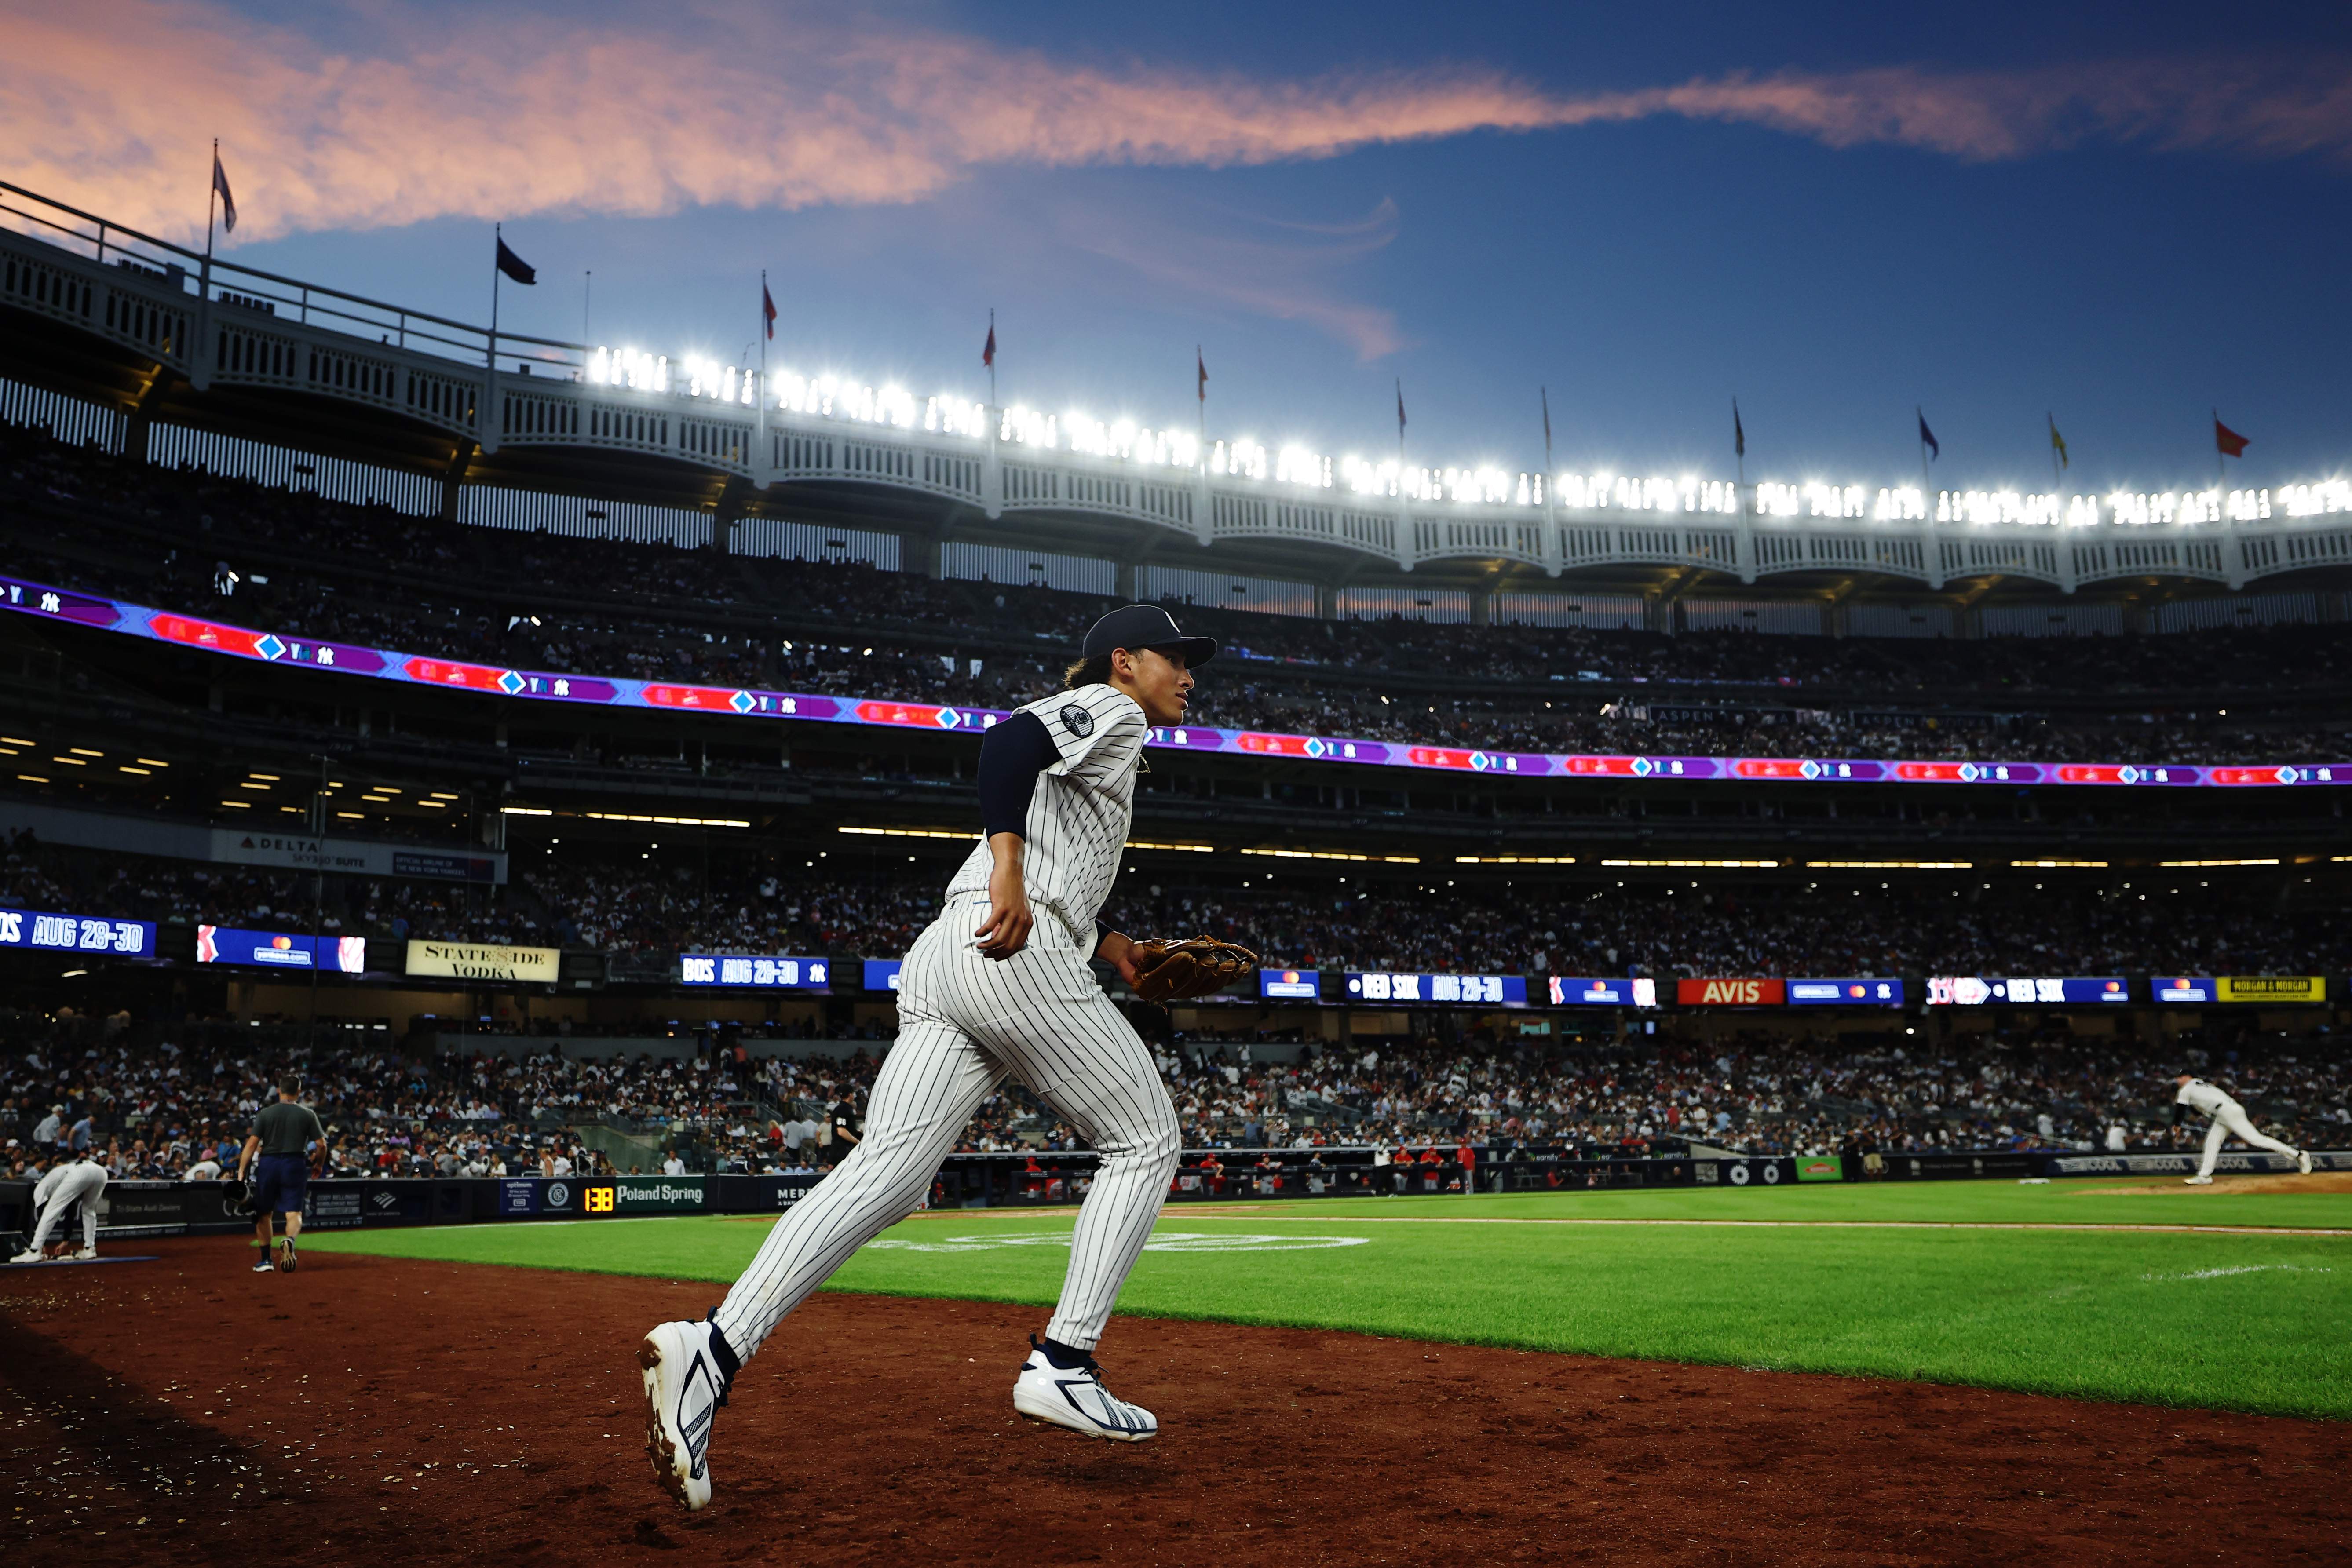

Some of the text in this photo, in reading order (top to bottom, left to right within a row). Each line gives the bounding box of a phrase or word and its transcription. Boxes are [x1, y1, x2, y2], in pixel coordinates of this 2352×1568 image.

[1659, 710, 1713, 721] ASPEN
[261, 838, 318, 853] DELTA
[336, 857, 365, 868] SUITE
[32, 915, 77, 947] AUG
[80, 919, 144, 952] 28-30
[425, 945, 545, 966] STATESIDE
[452, 963, 517, 980] VODKA
[682, 958, 799, 985] BOS AUG 28-30
[1362, 974, 1503, 1003] RED SOX AUG 28-30
[1702, 981, 1760, 1003] AVIS
[2006, 978, 2066, 1002] RED SOX
[2233, 980, 2267, 991] MORGAN
[2276, 980, 2309, 991] MORGAN
[617, 1185, 703, 1203] Poland Spring
